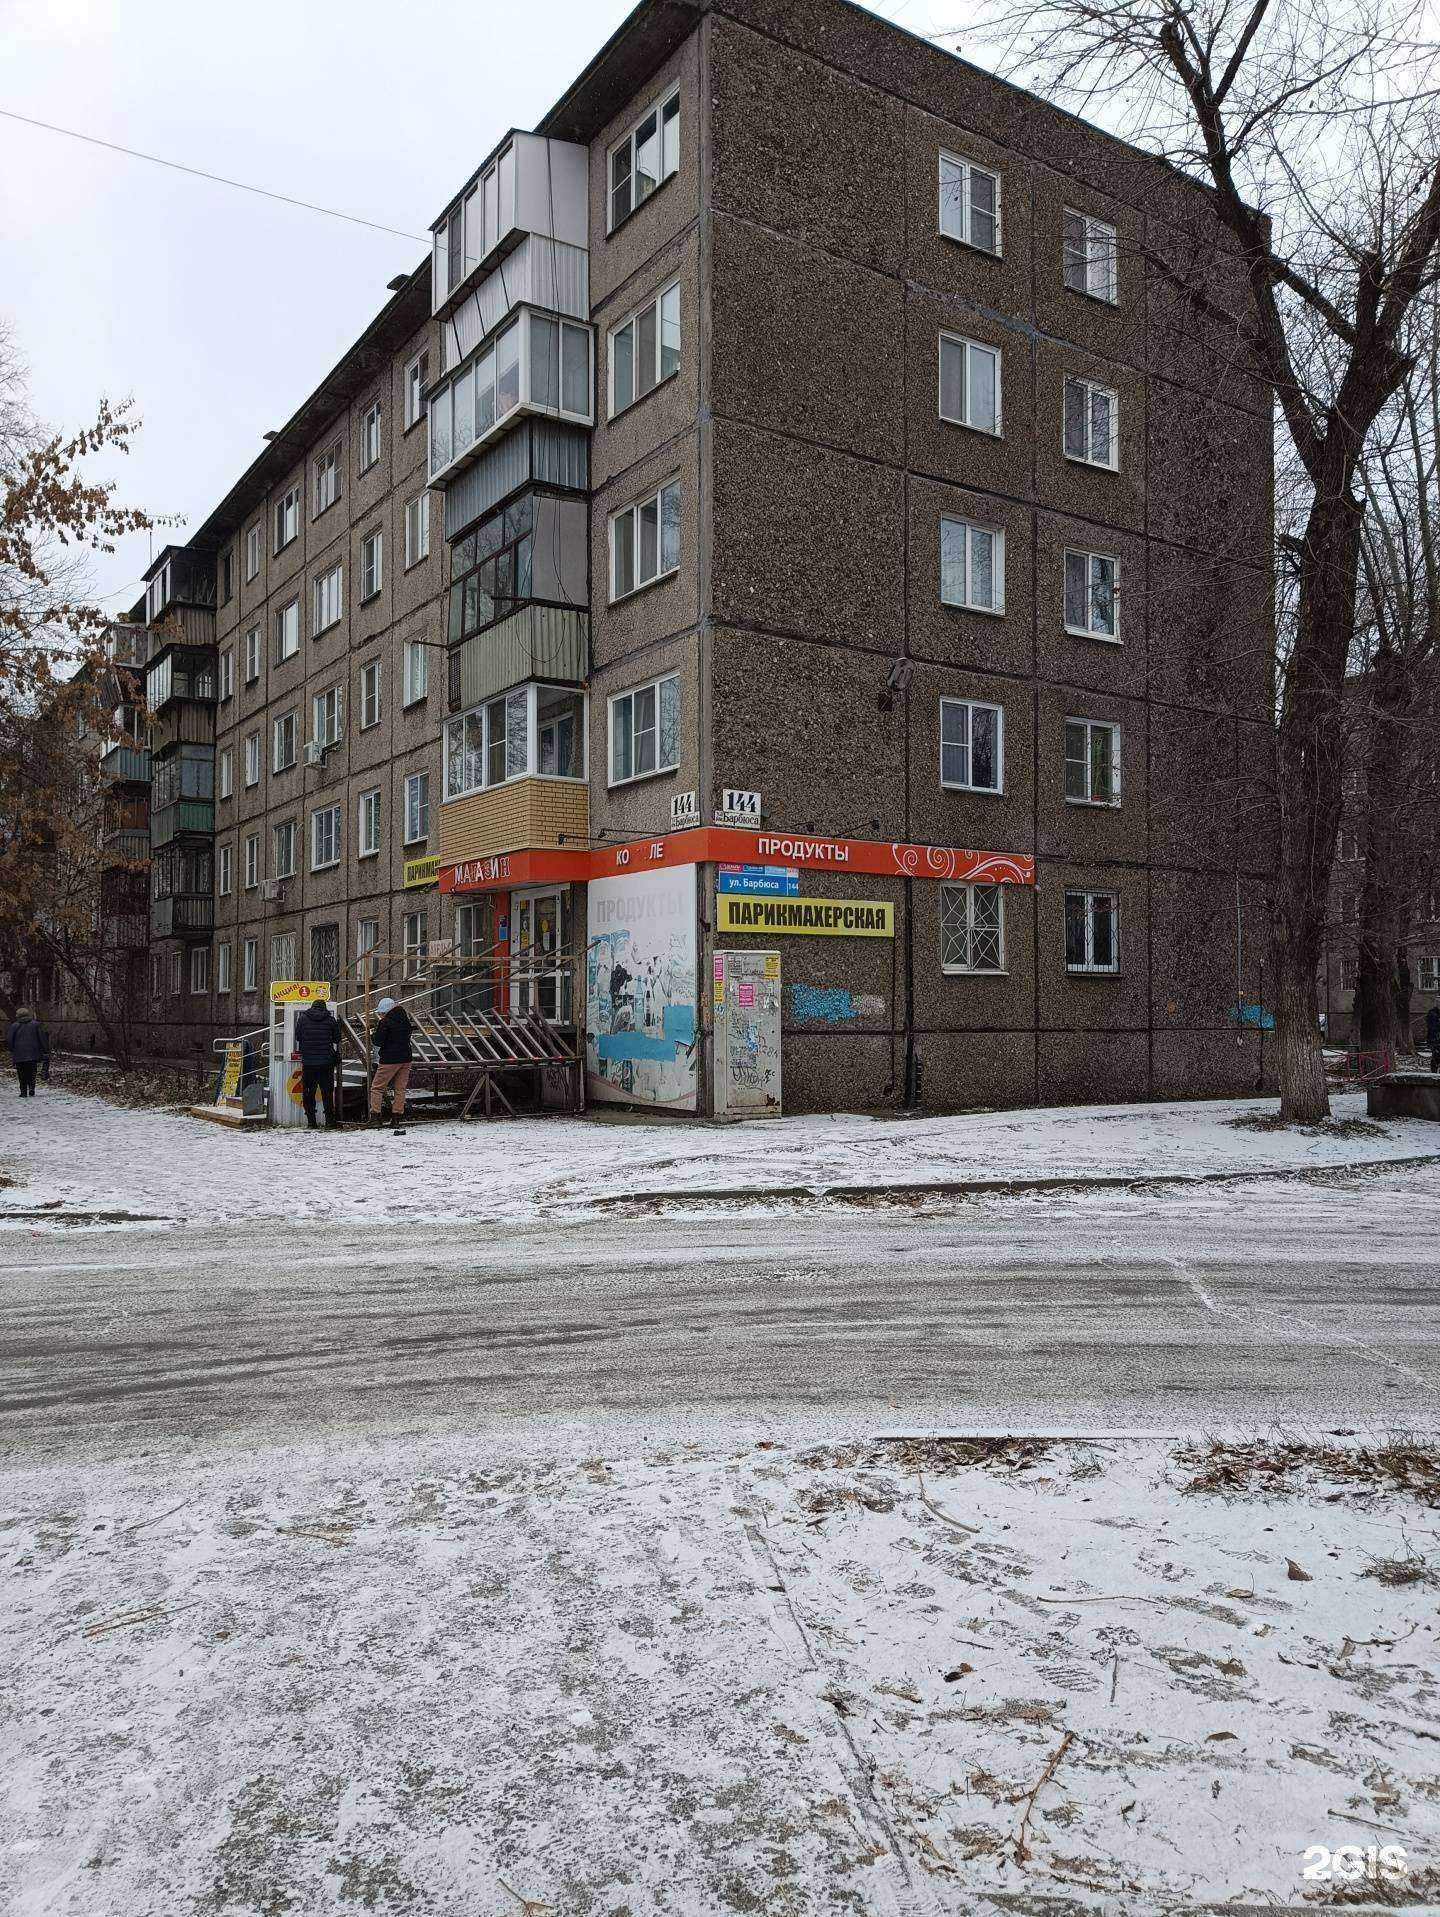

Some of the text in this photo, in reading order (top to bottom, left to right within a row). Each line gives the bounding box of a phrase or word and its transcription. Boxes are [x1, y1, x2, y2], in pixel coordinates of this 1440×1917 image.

[673, 793, 692, 815] 144
[726, 791, 756, 812] 144
[758, 838, 849, 861] ПРОДУКТЫ
[729, 879, 742, 888] ул.
[743, 878, 779, 889] Барбюса
[728, 901, 886, 929] ПАРИКМАХЕРСКАЯ
